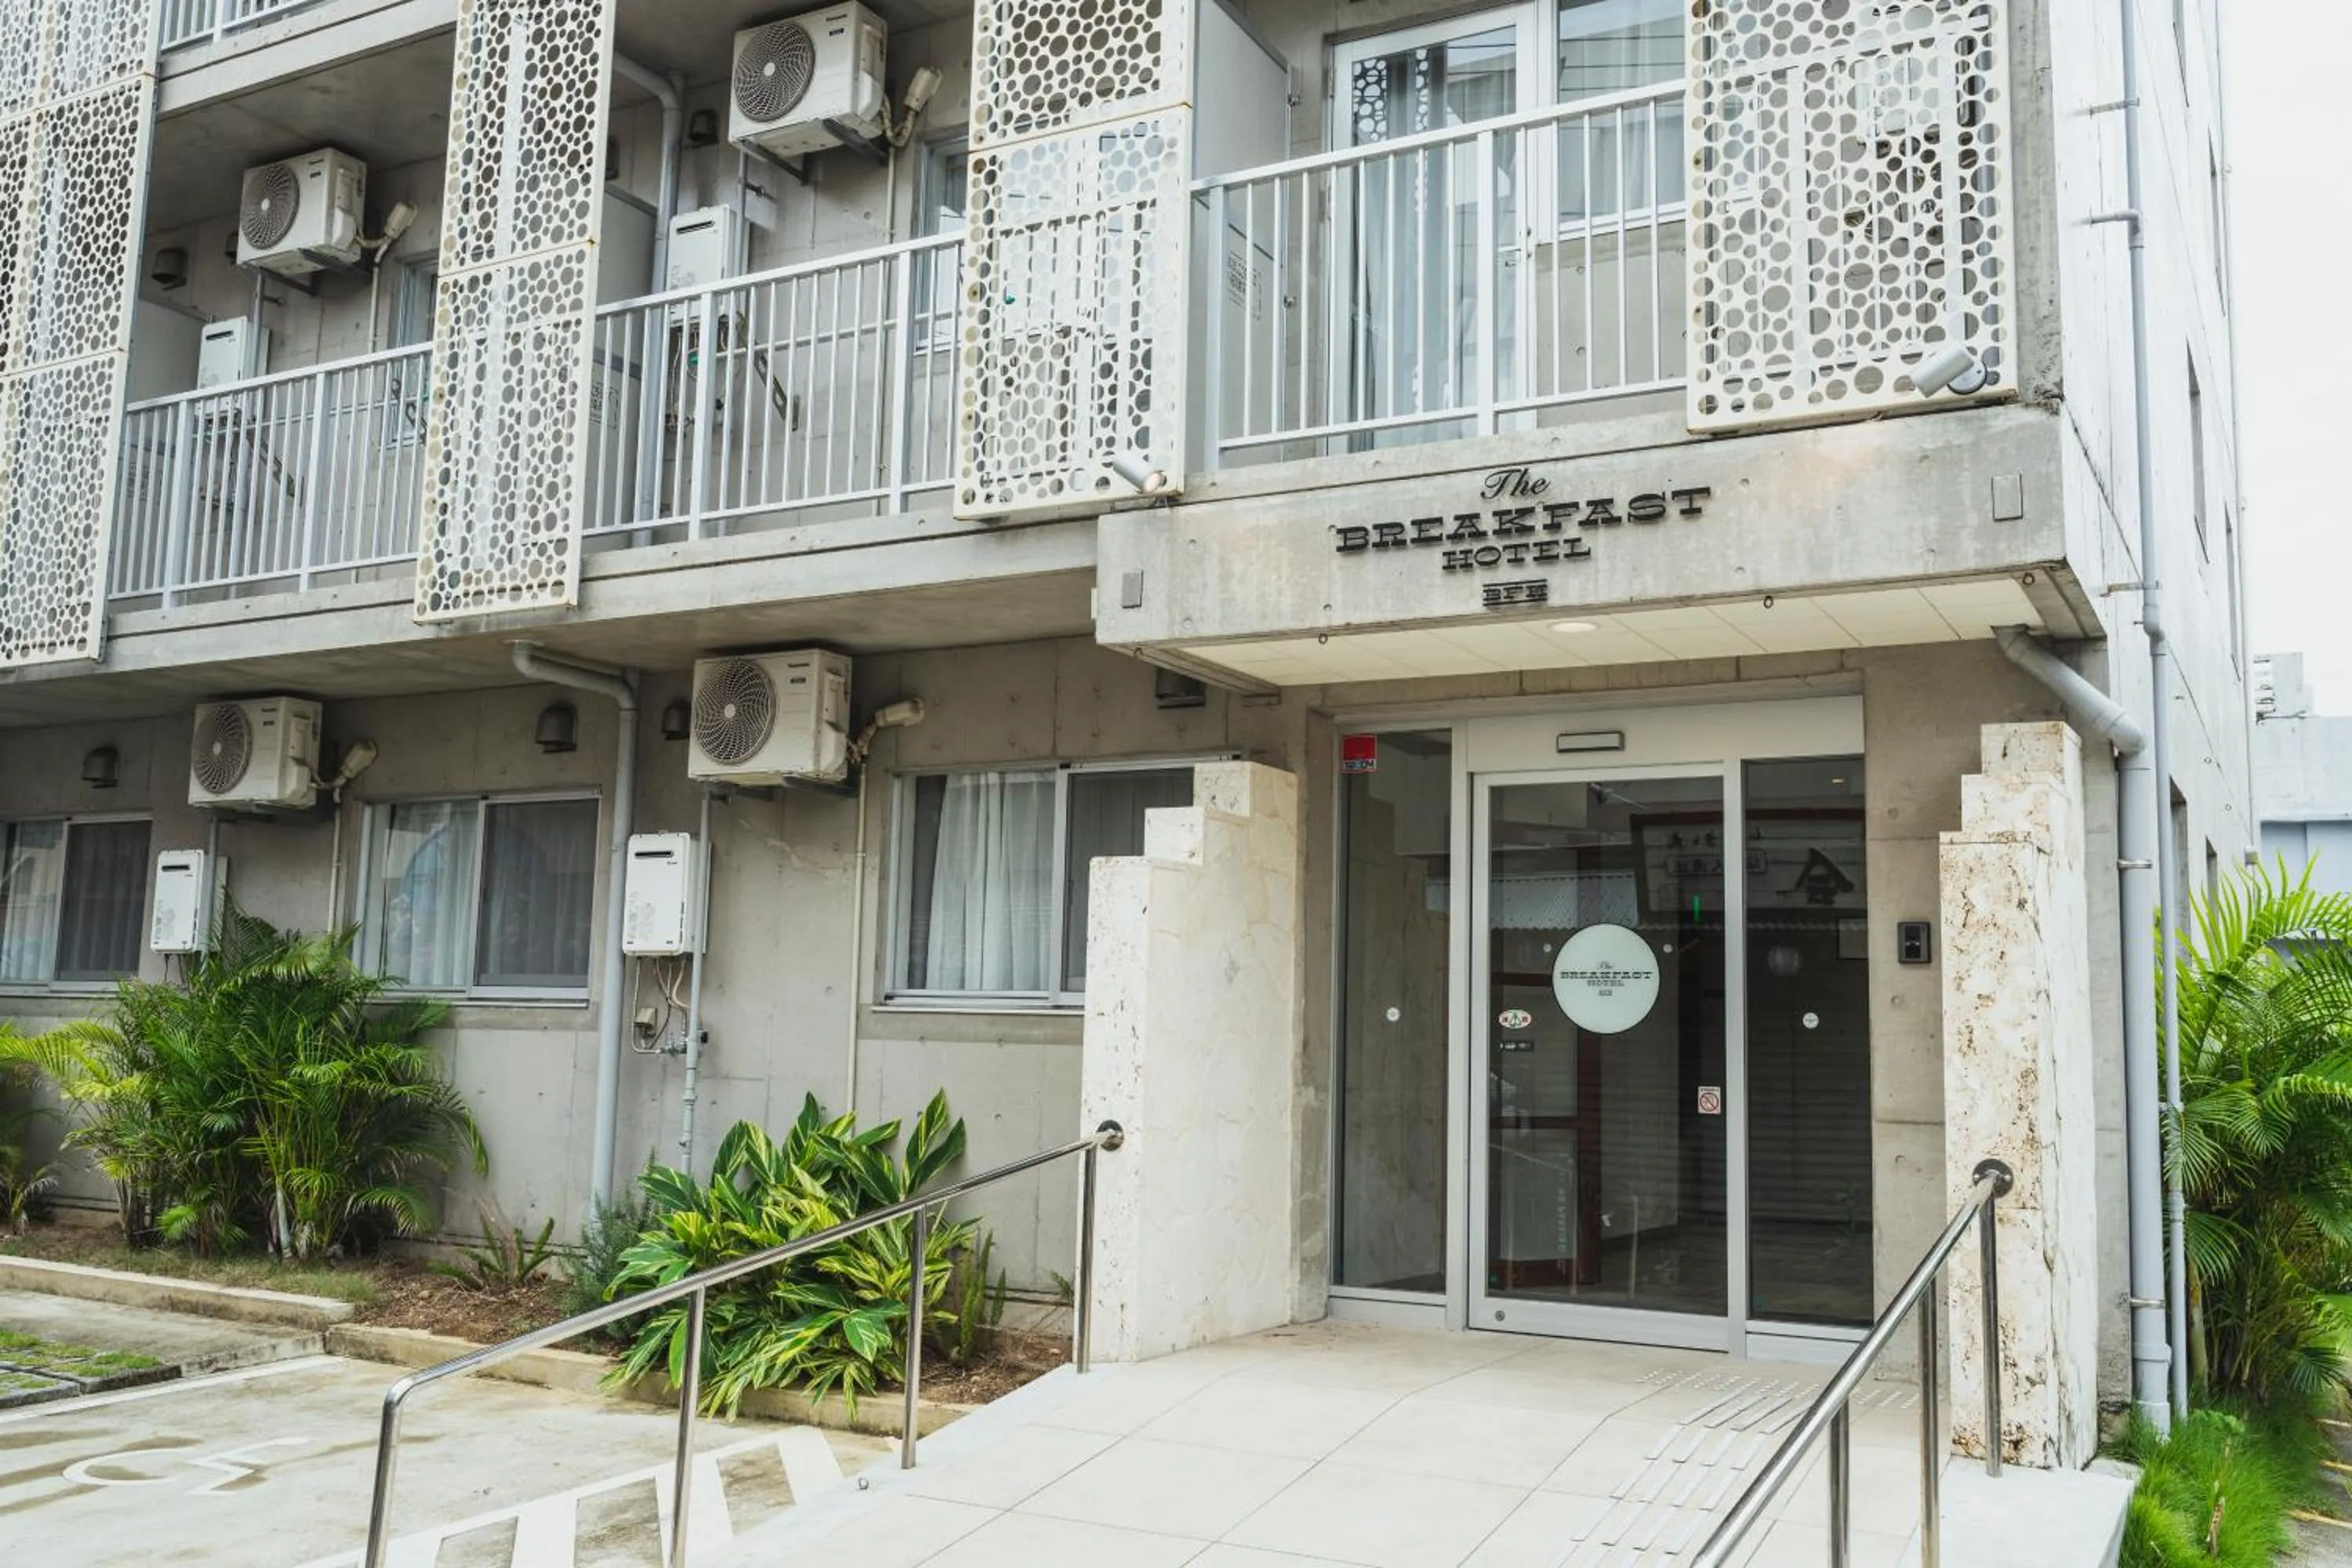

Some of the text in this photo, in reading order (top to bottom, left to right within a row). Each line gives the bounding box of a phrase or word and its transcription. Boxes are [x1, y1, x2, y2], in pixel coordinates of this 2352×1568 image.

[1480, 468, 1552, 499] The
[1336, 486, 1711, 553] BREAKFAST
[1442, 537, 1592, 571] HOTEL
